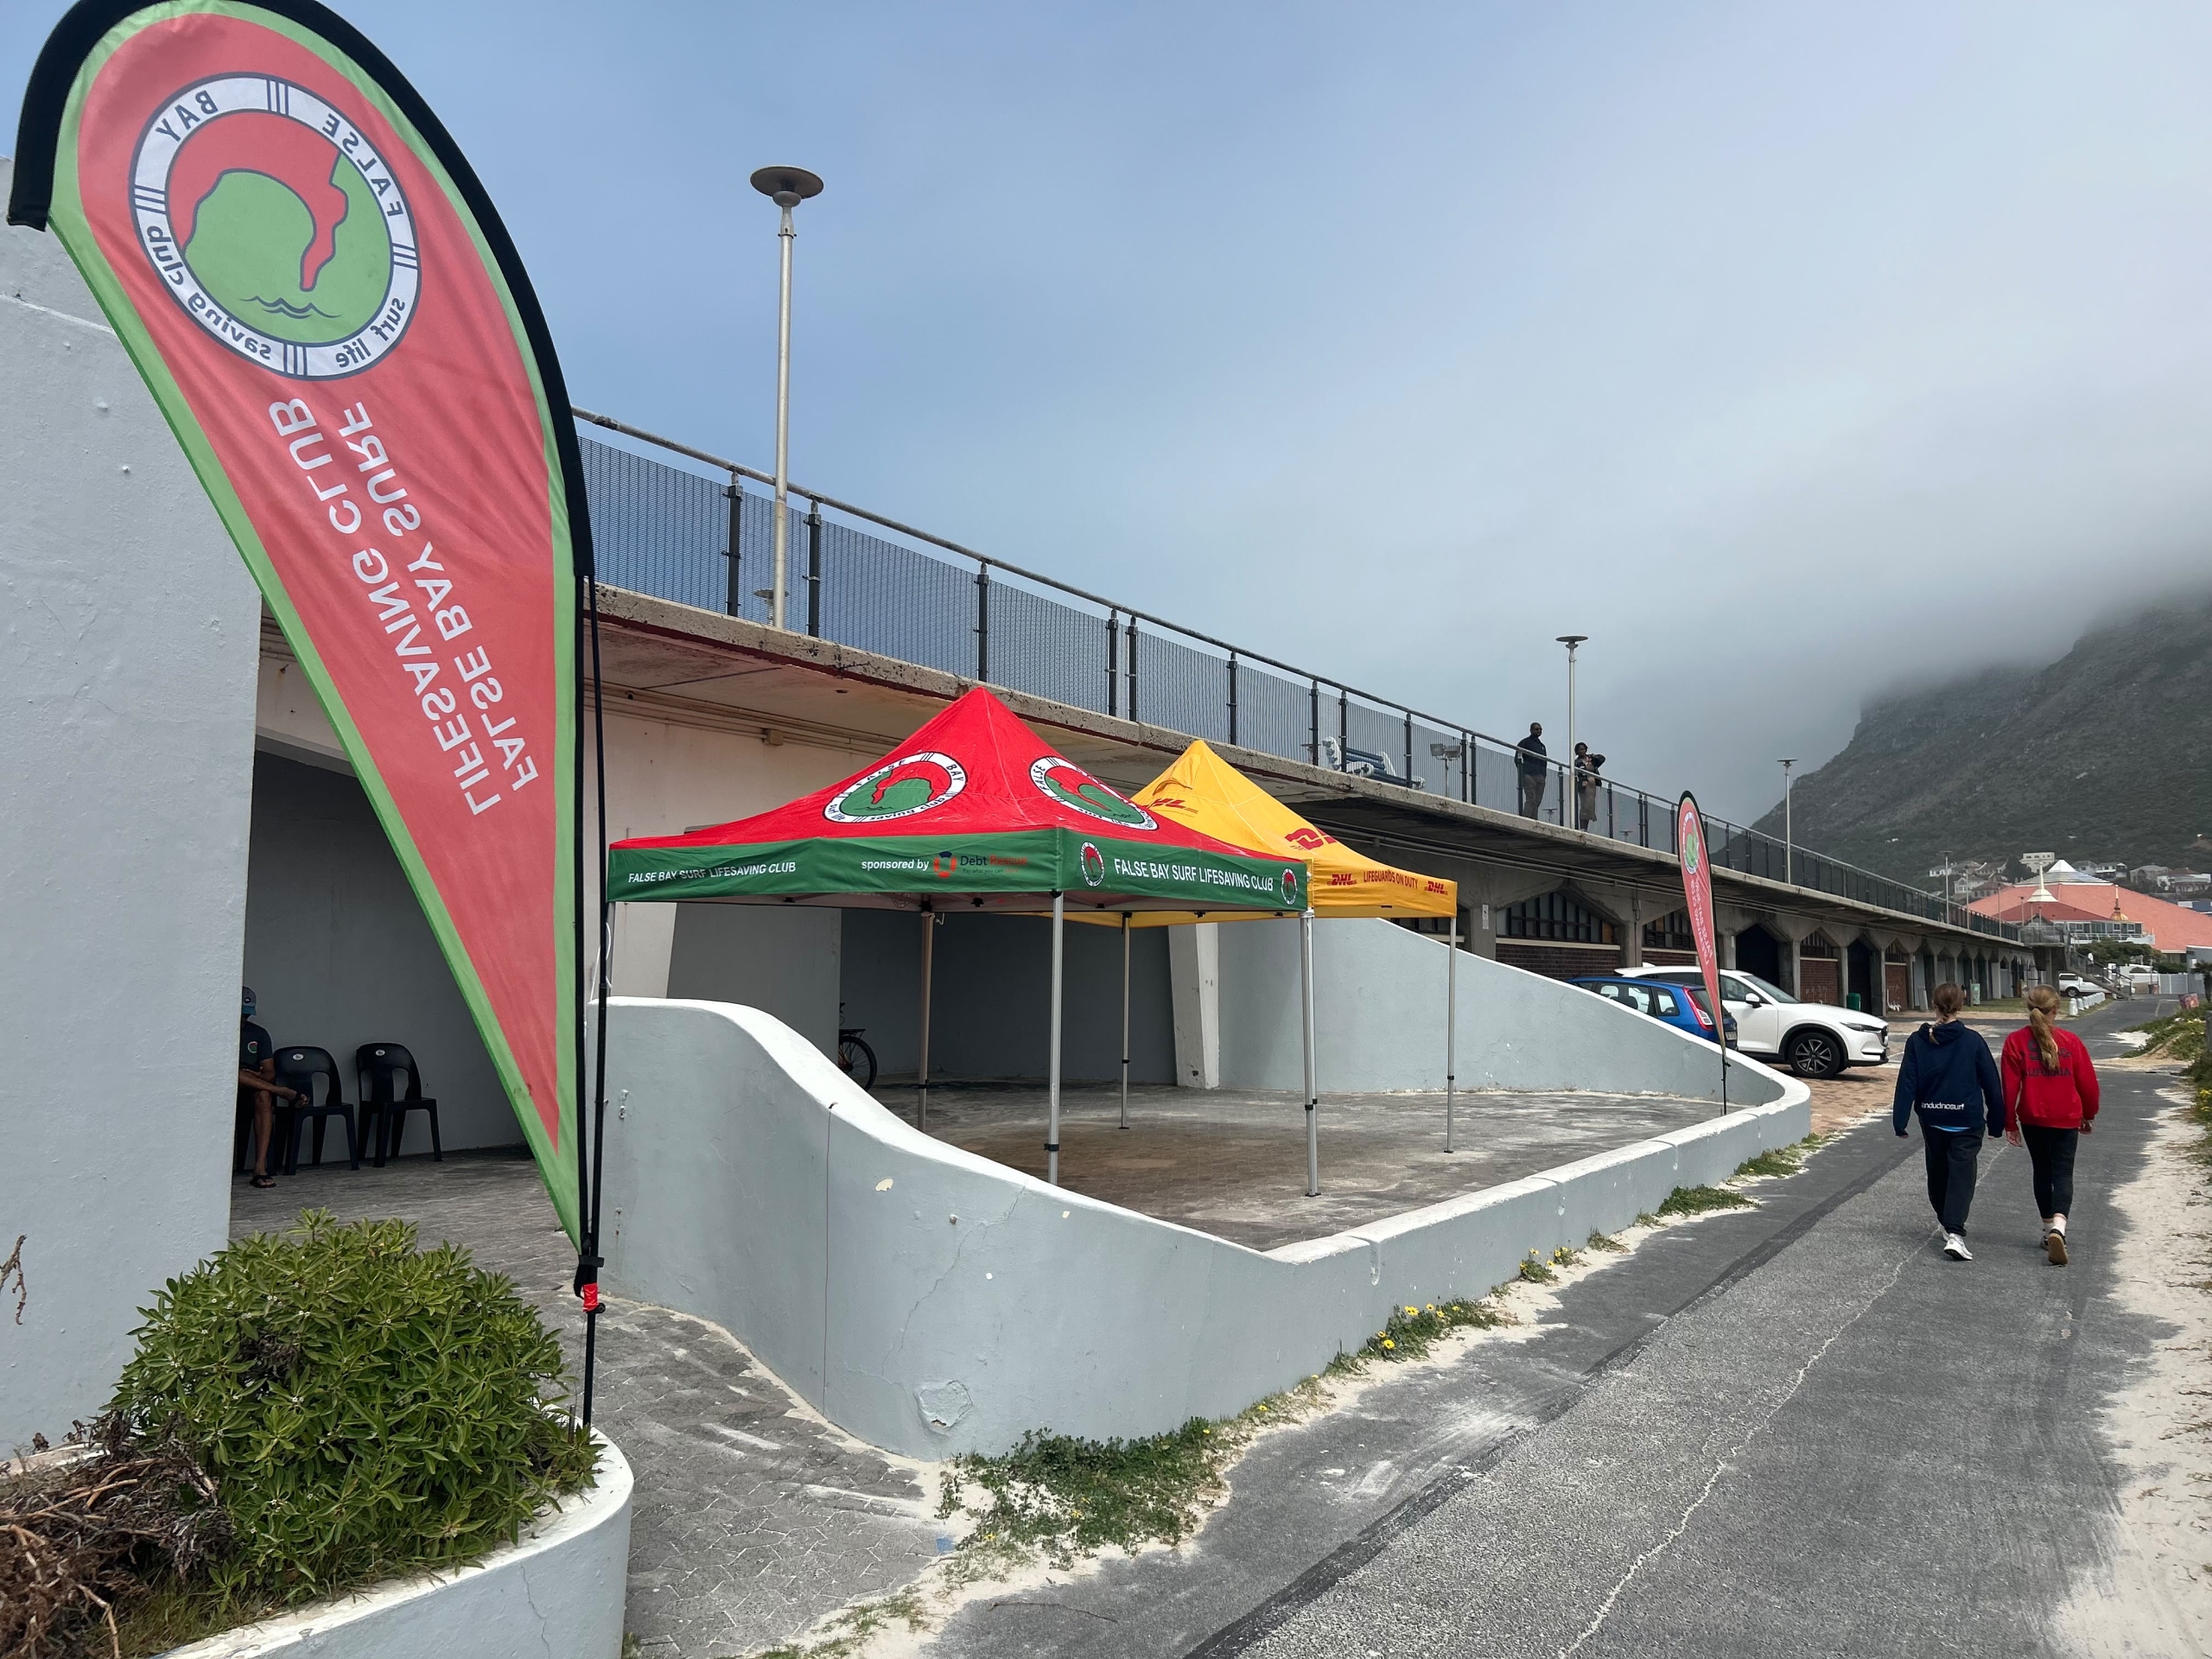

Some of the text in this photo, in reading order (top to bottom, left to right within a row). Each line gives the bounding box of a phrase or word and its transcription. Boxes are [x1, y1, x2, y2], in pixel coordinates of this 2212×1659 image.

[945, 764, 965, 782] BAY
[861, 859, 930, 873] sponsored by
[960, 854, 1028, 867] Debt Rescue
[627, 861, 797, 883] FALSE BAY SURF LIFESAVING CLUB
[1114, 858, 1149, 878] FALSE
[1149, 862, 1170, 880] BAY
[1172, 864, 1197, 882] SURF
[1198, 867, 1251, 889] LIFESAVING
[1251, 875, 1274, 892] CLUB
[1329, 873, 1354, 886] DHL
[1363, 869, 1419, 889] LIFEGUARDS ON DUTY
[1426, 880, 1446, 895] DHL
